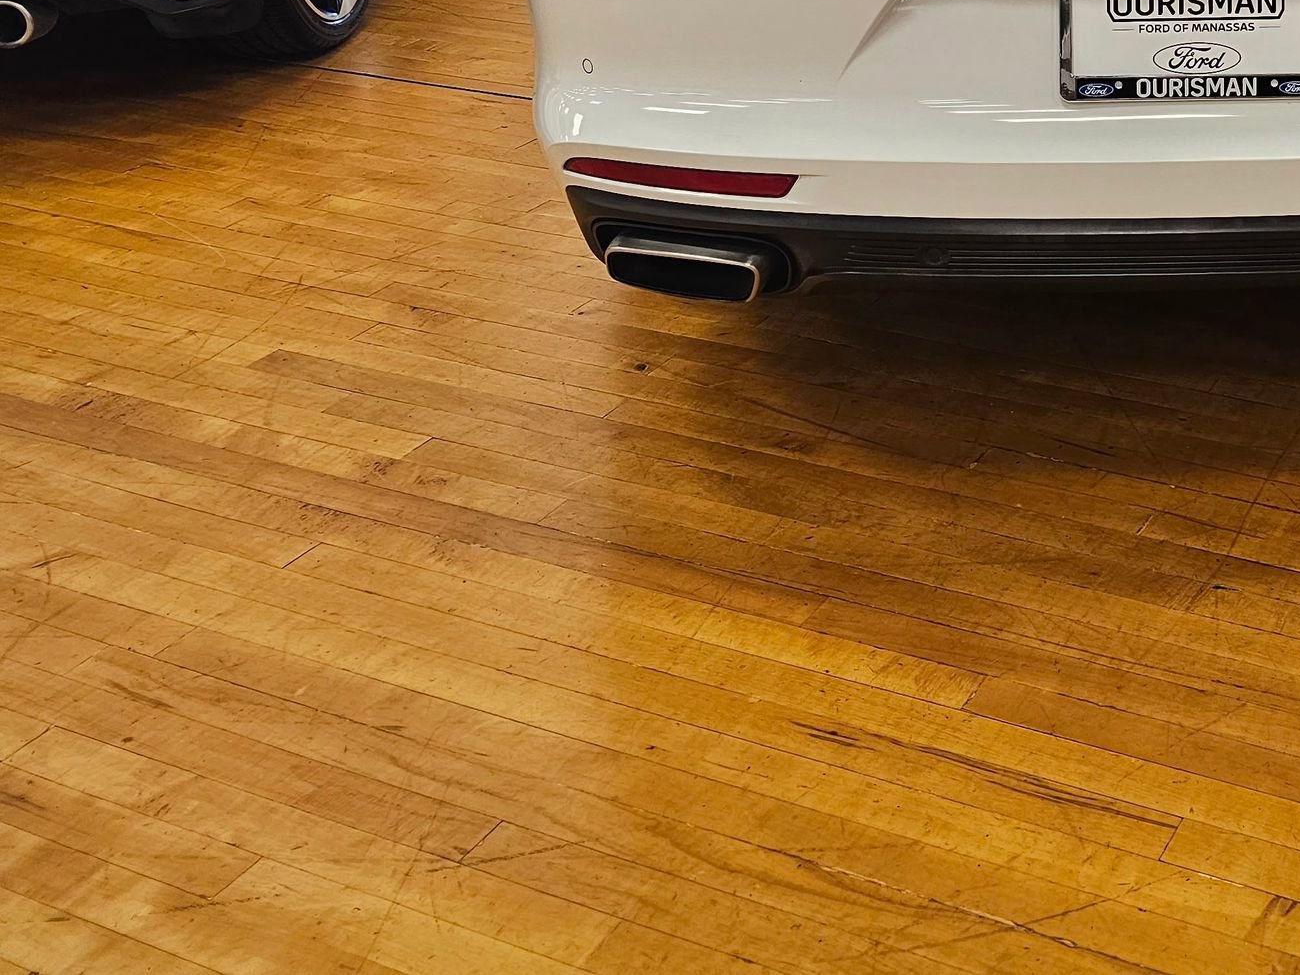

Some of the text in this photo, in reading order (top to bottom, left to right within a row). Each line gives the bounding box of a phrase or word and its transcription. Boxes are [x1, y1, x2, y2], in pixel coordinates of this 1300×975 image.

[1138, 22, 1255, 33] FORD OF MANASSAS
[1168, 46, 1225, 69] Ford
[1084, 85, 1108, 95] Ford
[1136, 77, 1258, 98] OURISMAN
